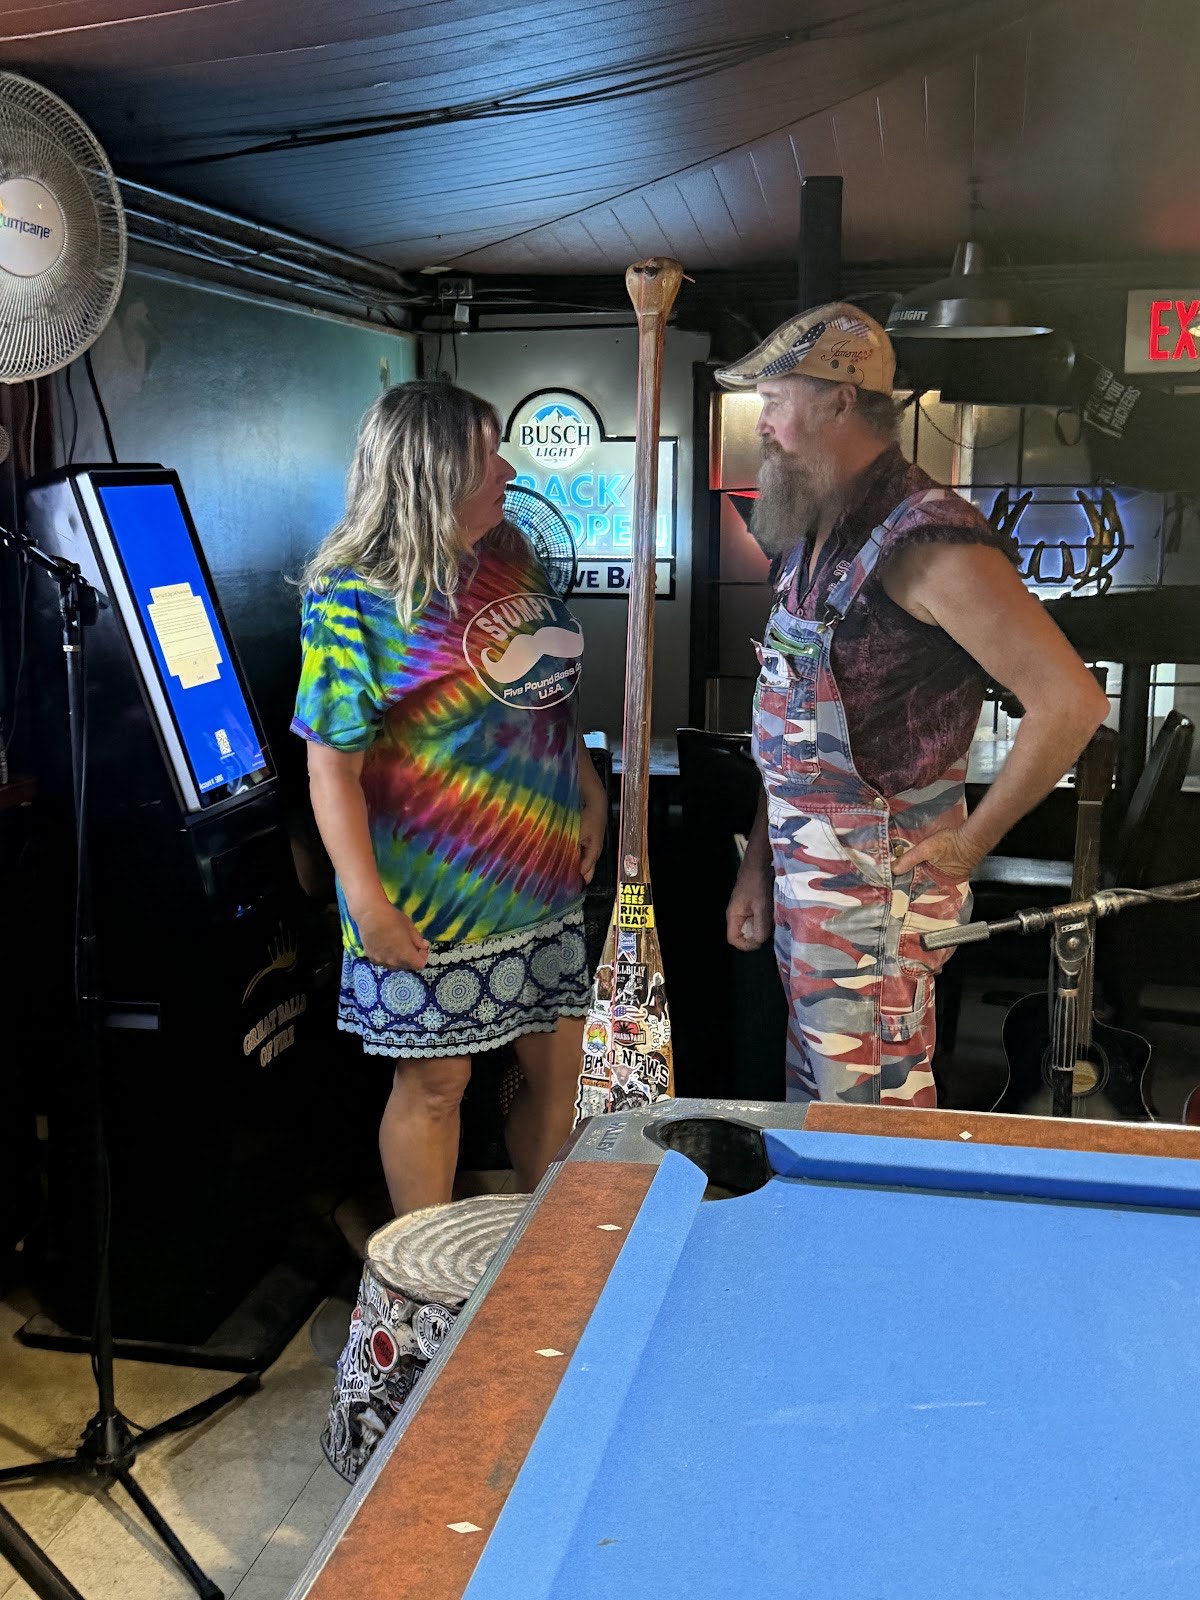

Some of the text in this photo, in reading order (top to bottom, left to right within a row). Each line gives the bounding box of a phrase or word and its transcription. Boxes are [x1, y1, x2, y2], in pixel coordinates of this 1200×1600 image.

[1, 213, 51, 239] urricane
[900, 310, 928, 320] LIGHT
[1149, 300, 1200, 360] EX
[521, 425, 591, 446] BUSCH
[536, 447, 577, 457] LIGHT
[563, 512, 667, 548] OPE
[574, 570, 600, 588] VE
[503, 686, 524, 700] Five
[524, 674, 554, 692] Pound
[554, 667, 576, 682] Bass
[620, 916, 648, 925] EAD
[621, 905, 650, 915] RINK
[617, 965, 646, 977] LLBILLY
[243, 993, 306, 1056] GREAT BALLS
[260, 1024, 294, 1067] OF FIRE
[622, 1049, 669, 1087] NEWS
